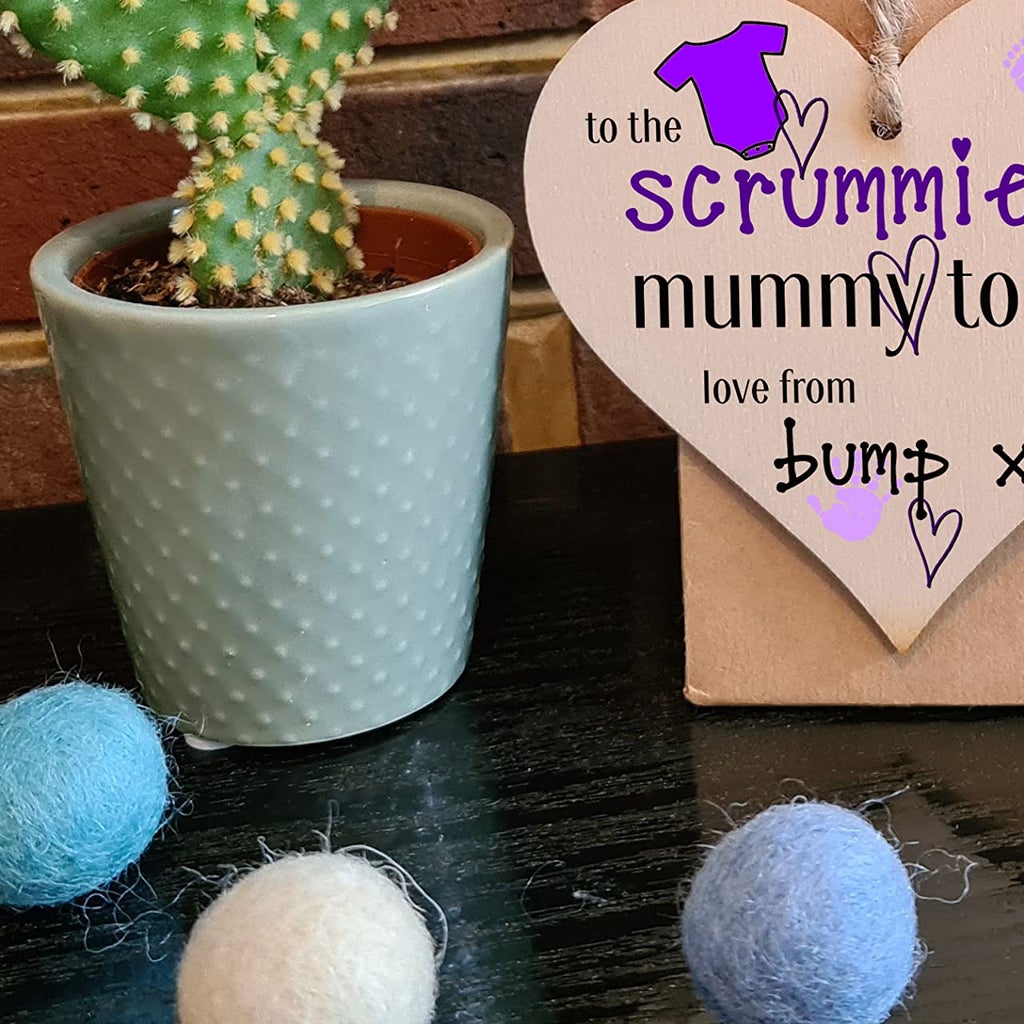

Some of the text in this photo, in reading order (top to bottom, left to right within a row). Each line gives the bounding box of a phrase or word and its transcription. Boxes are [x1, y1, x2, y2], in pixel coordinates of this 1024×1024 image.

[585, 108, 682, 144] to the
[634, 272, 926, 358] mummy
[946, 259, 1019, 329] to
[703, 368, 855, 405] love from
[773, 416, 950, 521] bump
